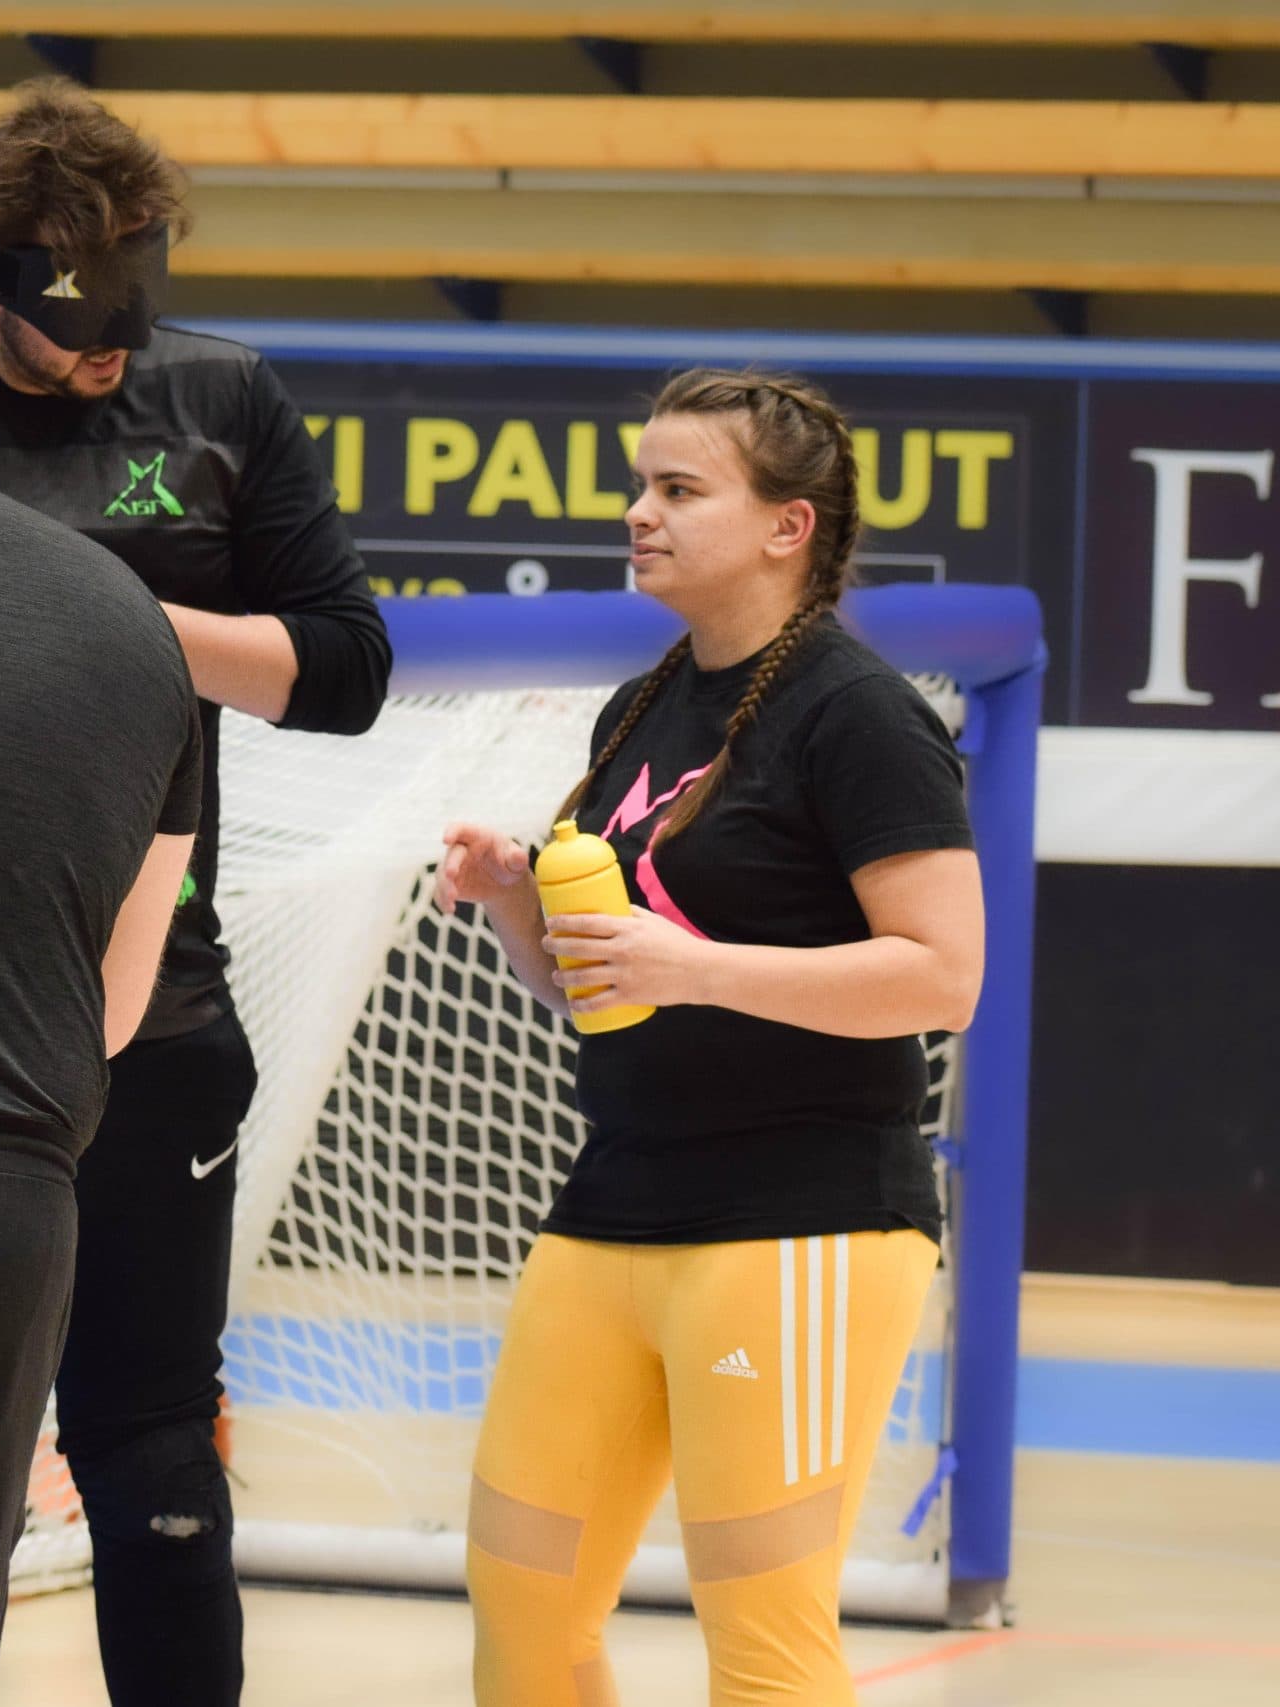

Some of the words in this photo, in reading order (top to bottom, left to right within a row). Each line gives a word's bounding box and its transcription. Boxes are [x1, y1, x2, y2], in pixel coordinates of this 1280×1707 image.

[404, 417, 1014, 529] PALUT
[1127, 447, 1280, 709] F
[711, 1364, 759, 1379] adidas
